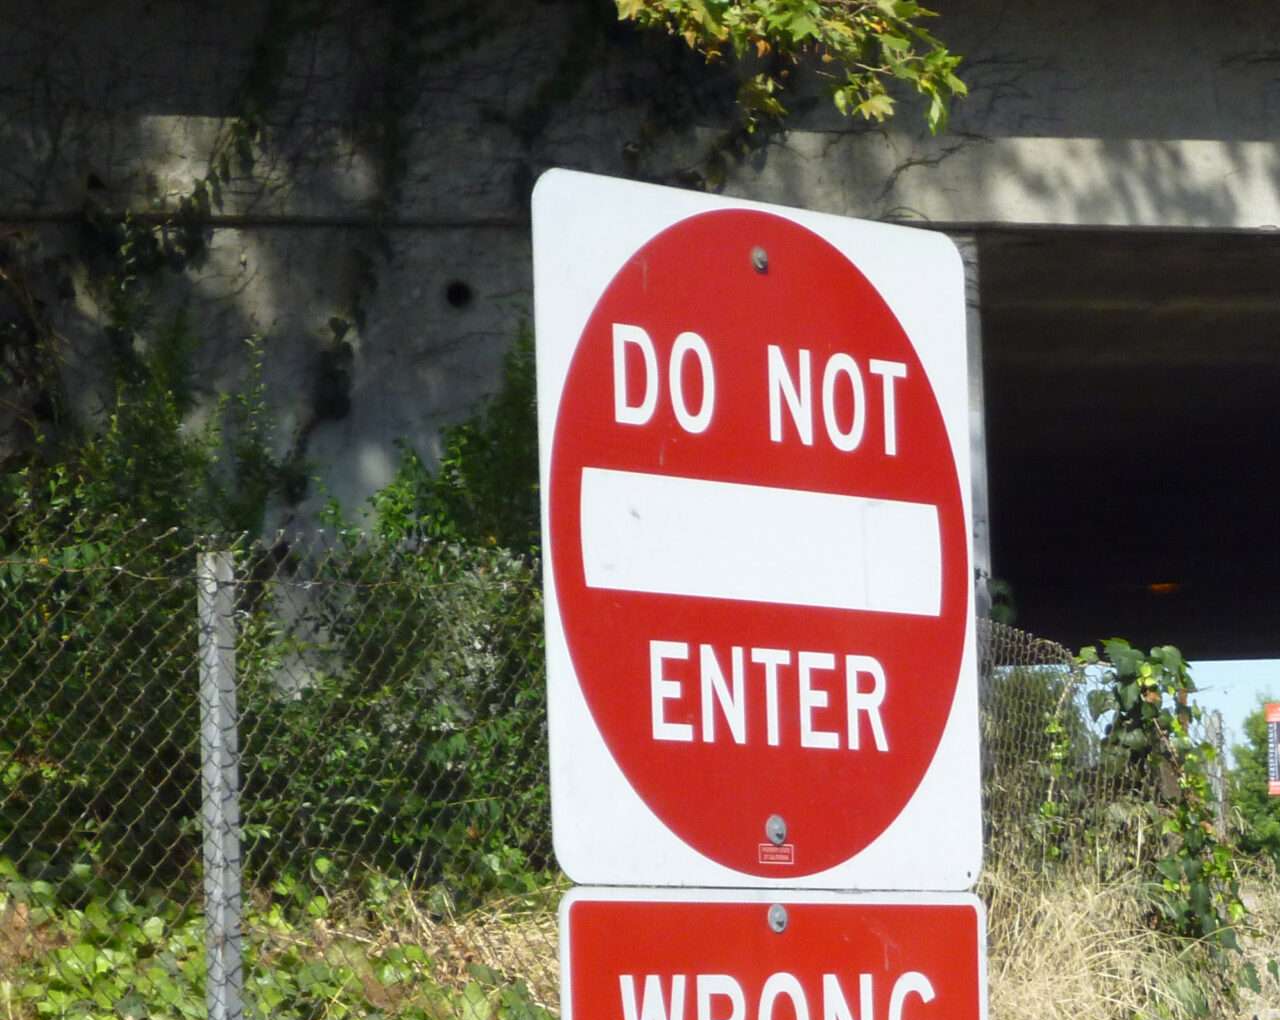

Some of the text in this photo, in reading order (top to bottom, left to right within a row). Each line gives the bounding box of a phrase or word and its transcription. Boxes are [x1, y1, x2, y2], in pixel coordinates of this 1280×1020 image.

[612, 323, 906, 456] DO NOT
[649, 639, 889, 752] ENTER
